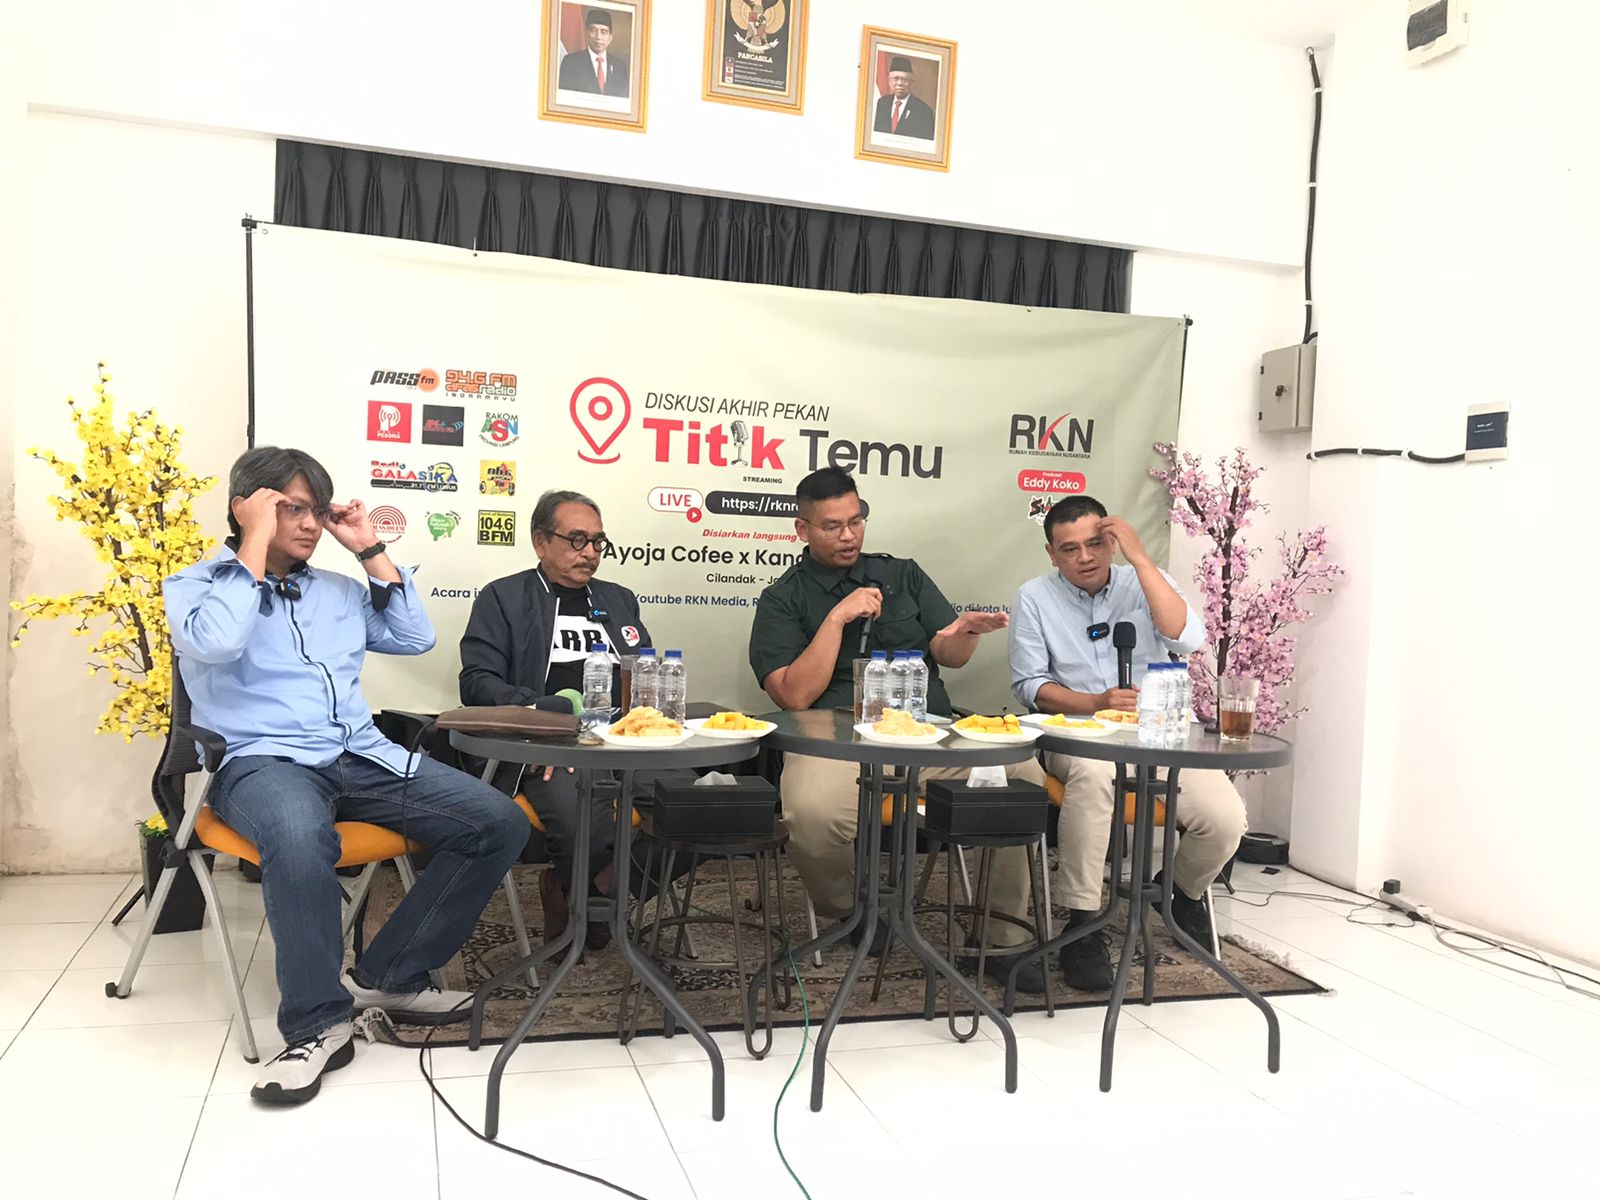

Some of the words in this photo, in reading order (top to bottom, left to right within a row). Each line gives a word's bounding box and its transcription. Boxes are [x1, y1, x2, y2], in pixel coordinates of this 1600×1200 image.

[737, 52, 773, 63] PANCASILA
[489, 373, 517, 388] FM
[645, 392, 715, 414] DISKUSI
[717, 398, 770, 418] AKHIR
[772, 402, 830, 422] PEKAN
[486, 412, 518, 421] RAKOM
[1009, 412, 1094, 453] RKN
[799, 429, 943, 479] Temu
[743, 476, 782, 484] STREAMING
[1023, 477, 1050, 491] Eddy
[1052, 479, 1080, 490] Koko
[660, 493, 692, 507] LIVE
[480, 517, 514, 531] 104.6
[702, 529, 750, 539] Disiarkan
[753, 532, 798, 543] langsung
[602, 543, 665, 566] Ayoja
[672, 545, 733, 564] Cofee
[739, 551, 750, 565] x
[706, 573, 756, 585] Cilandak
[431, 587, 470, 598] Acara
[685, 595, 708, 605] RKN
[711, 596, 749, 608] Media,
[976, 604, 1000, 613] kota
